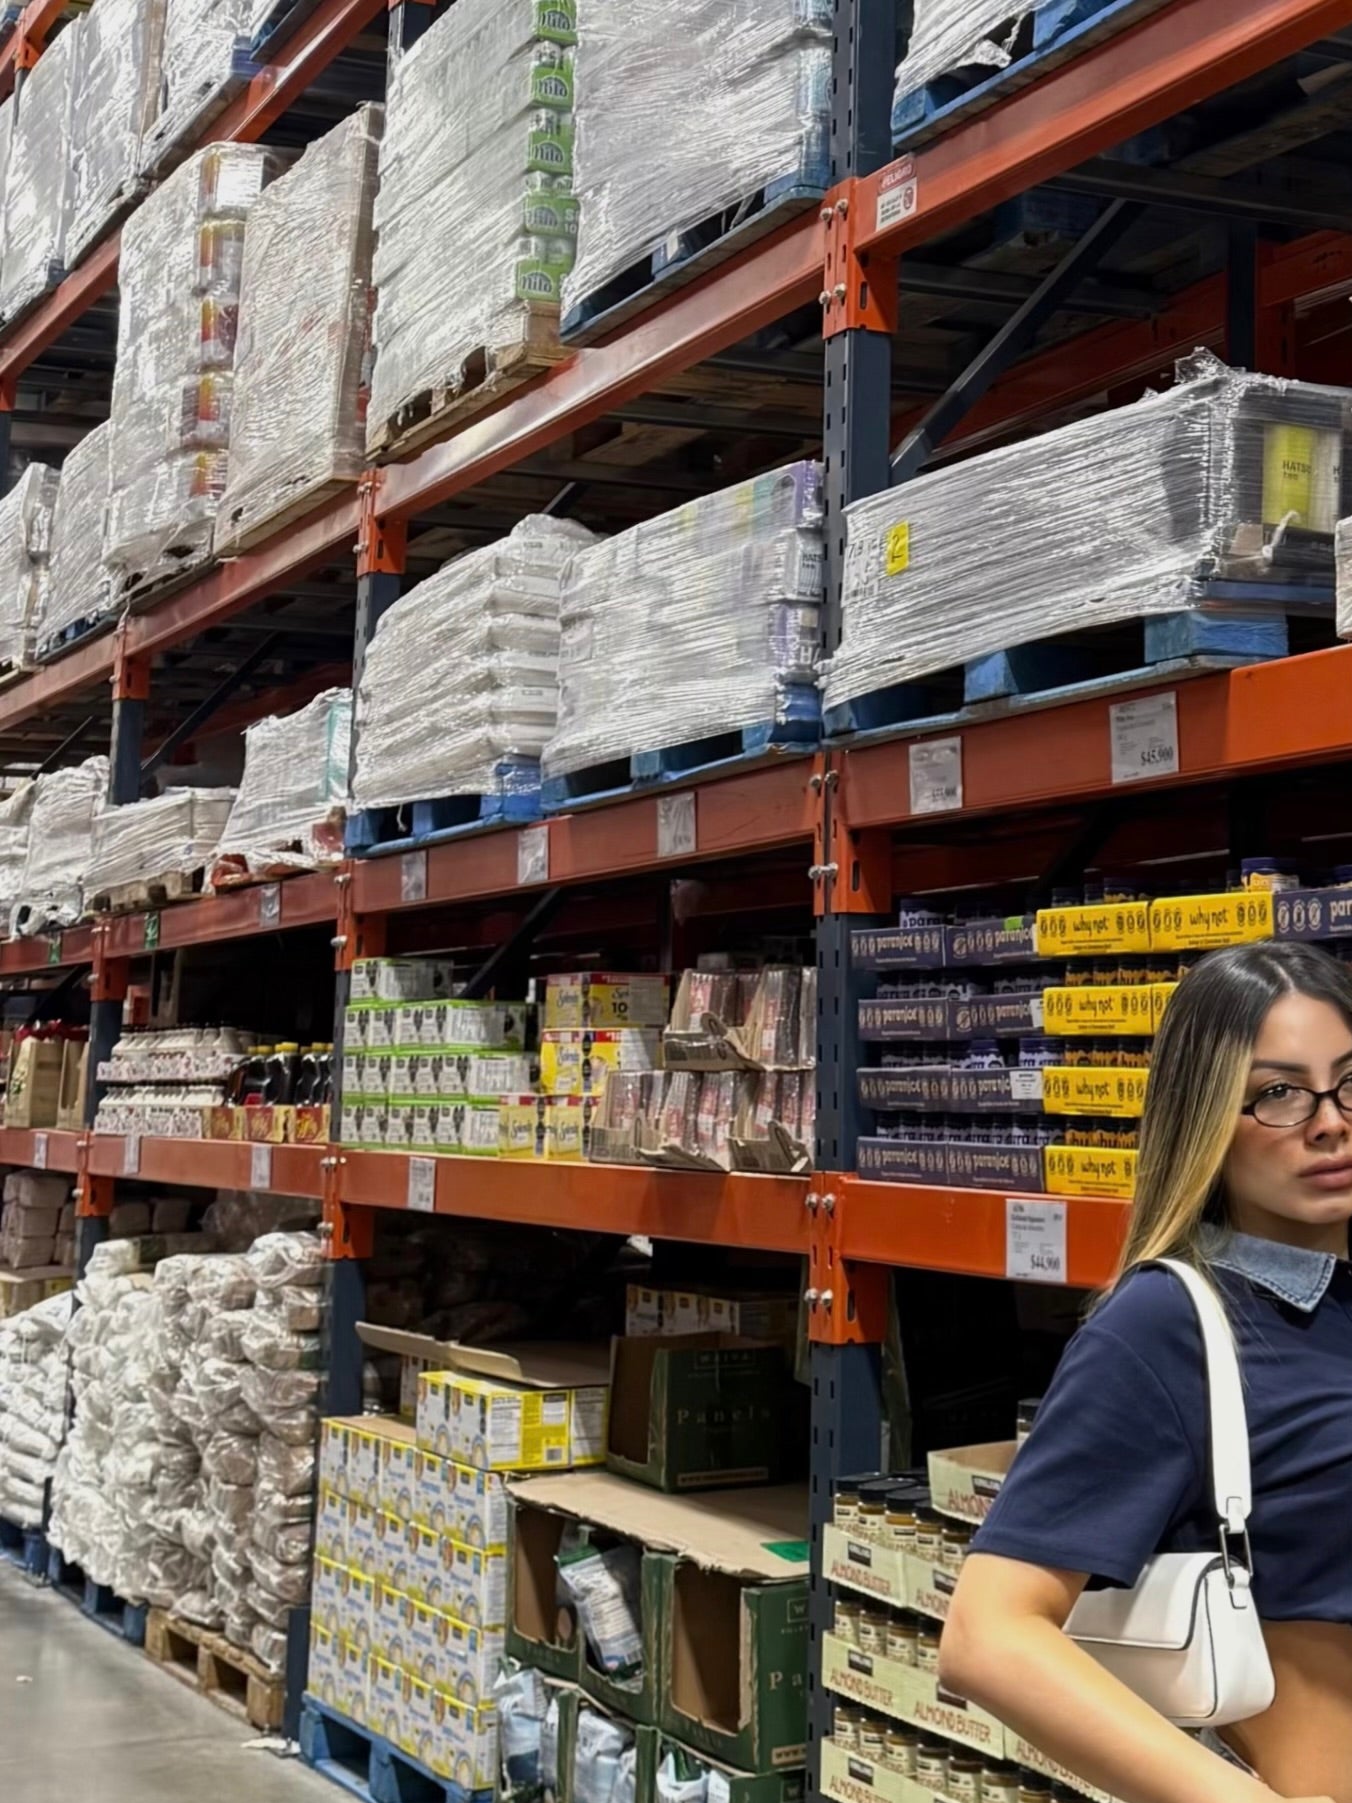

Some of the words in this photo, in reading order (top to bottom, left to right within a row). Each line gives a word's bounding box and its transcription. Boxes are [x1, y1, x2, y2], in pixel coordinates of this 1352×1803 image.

[1073, 914, 1092, 936] why
[1094, 917, 1108, 936] not
[1189, 907, 1210, 929] why
[1212, 910, 1228, 929] not
[1079, 994, 1097, 1017] why
[1099, 997, 1112, 1015] not
[914, 1701, 952, 1733] ALMOND
[954, 1715, 991, 1745] BUTTER
